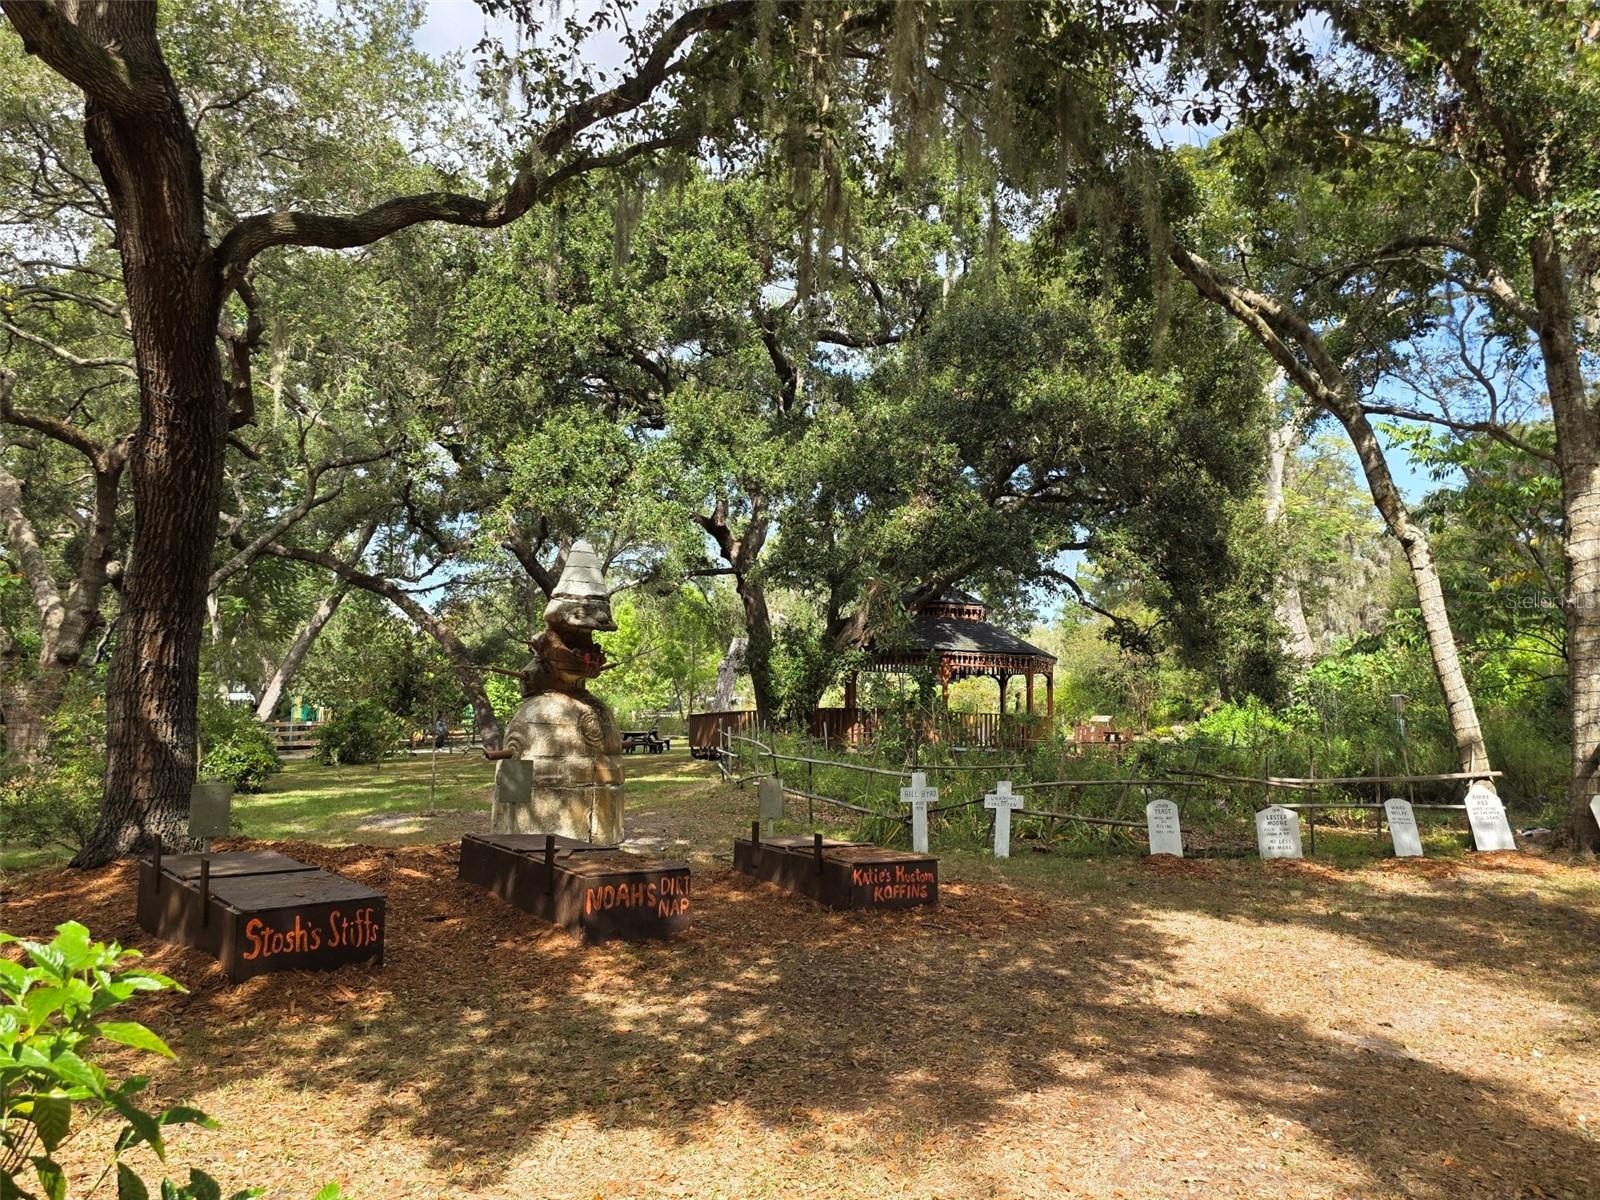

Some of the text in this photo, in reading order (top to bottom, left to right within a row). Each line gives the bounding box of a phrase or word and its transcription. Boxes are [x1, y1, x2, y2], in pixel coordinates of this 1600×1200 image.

[660, 876, 690, 896] DIRT
[873, 884, 928, 902] KOFFINS
[658, 897, 690, 918] NAP
[242, 907, 379, 961] Stosh's Stiffs
